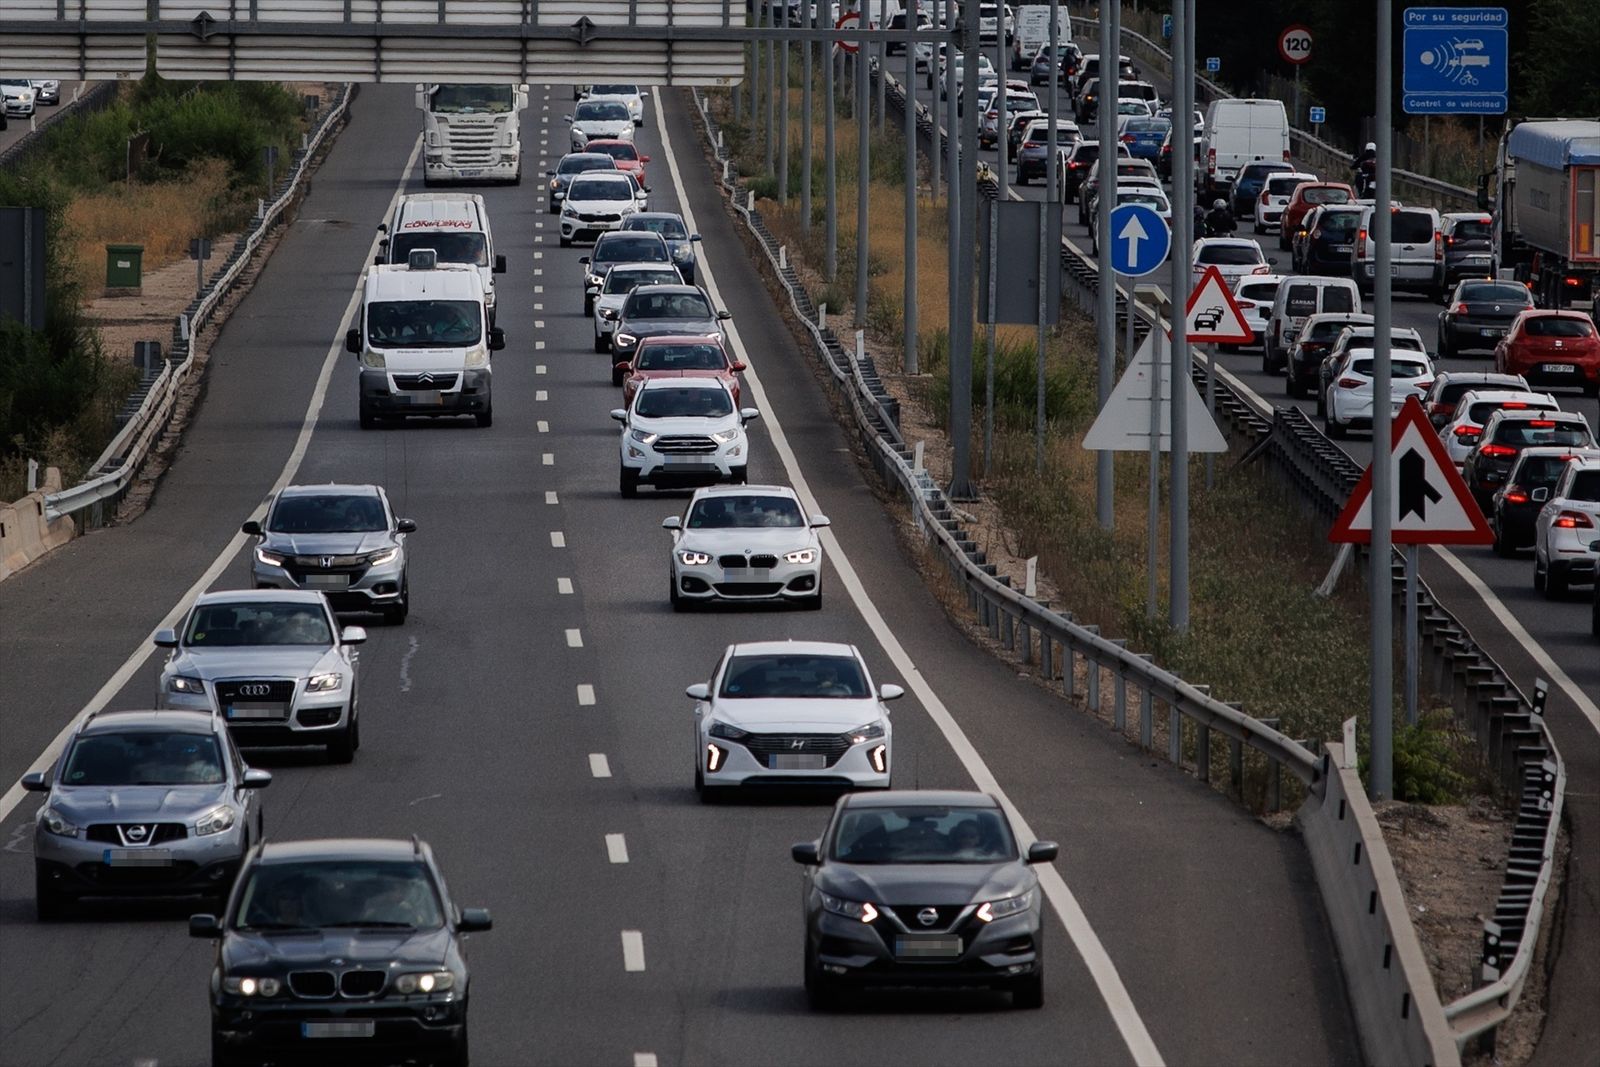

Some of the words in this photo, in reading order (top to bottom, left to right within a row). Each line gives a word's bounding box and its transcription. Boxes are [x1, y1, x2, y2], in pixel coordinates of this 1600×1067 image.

[1409, 12, 1426, 21] Por
[1451, 12, 1502, 23] seguridad
[1286, 38, 1311, 51] 120
[1409, 99, 1441, 108] Control
[1446, 100, 1456, 108] de
[1461, 100, 1500, 108] velocidad
